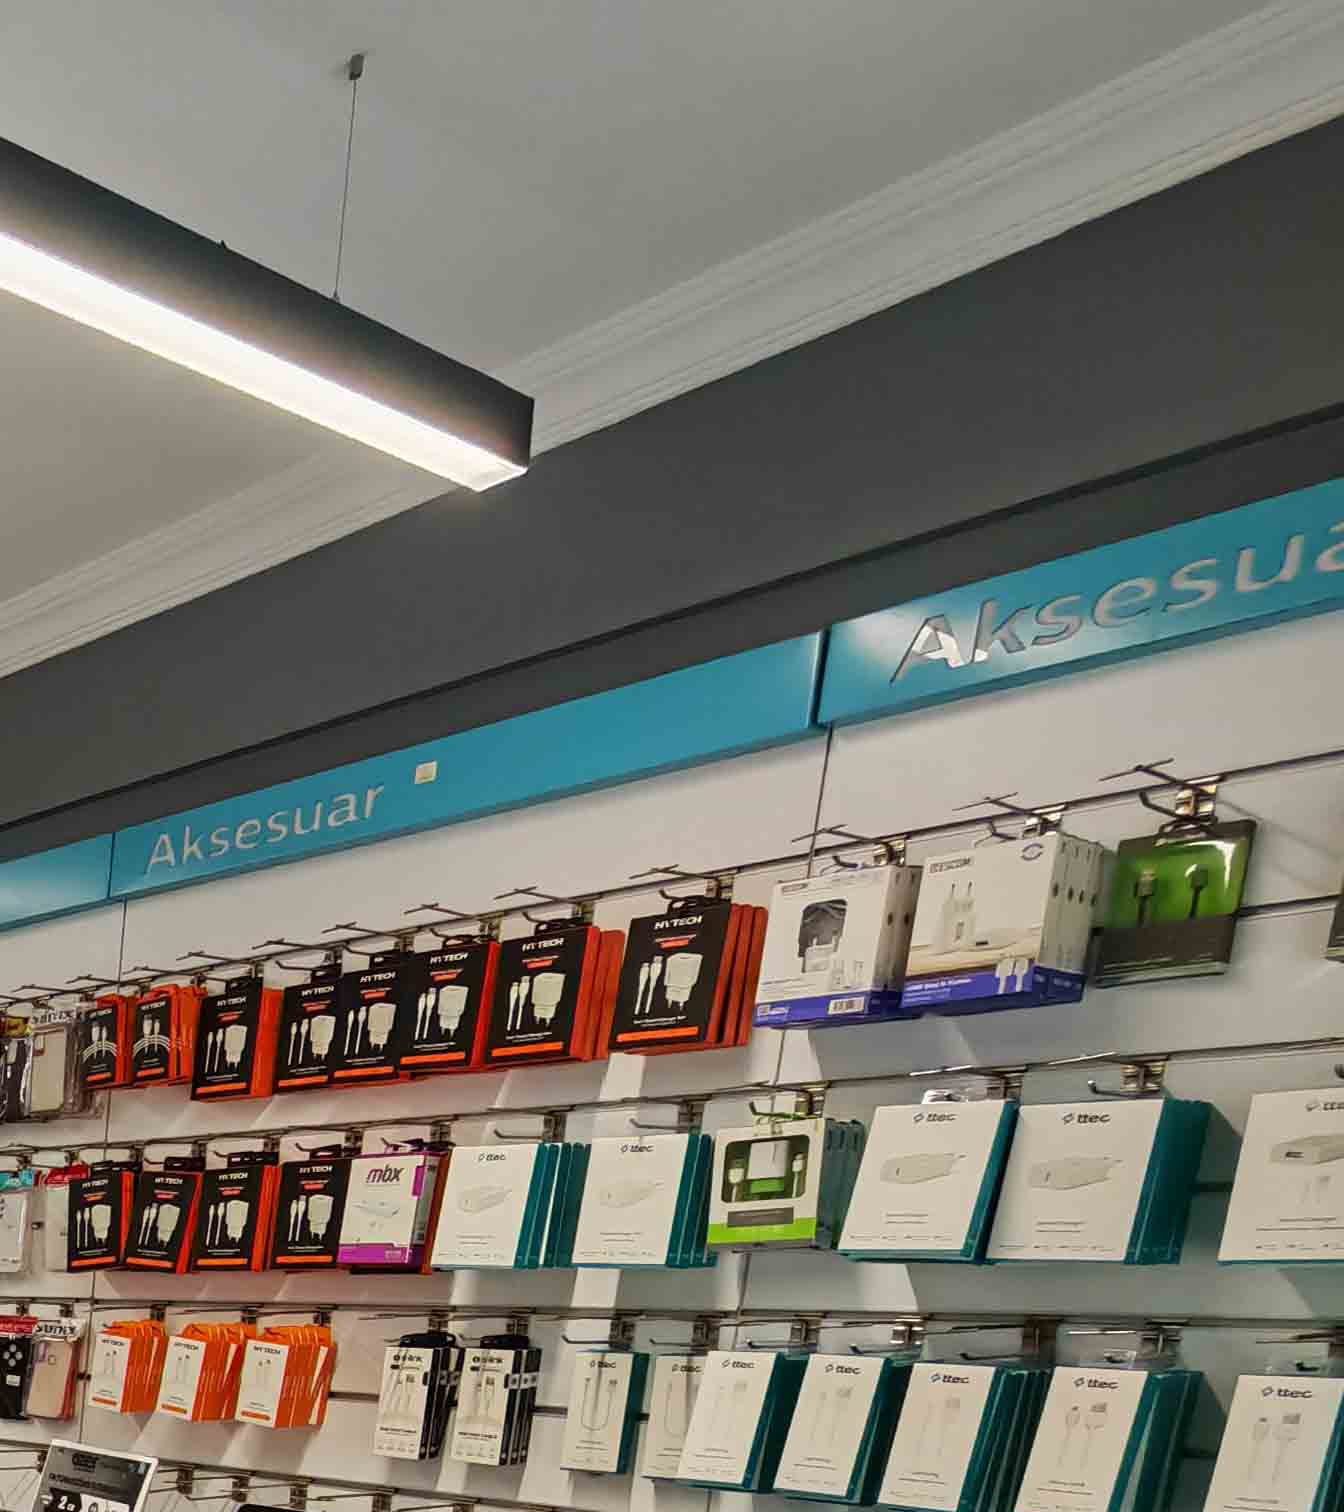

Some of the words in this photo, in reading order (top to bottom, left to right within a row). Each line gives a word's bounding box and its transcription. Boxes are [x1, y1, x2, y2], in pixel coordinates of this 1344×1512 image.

[144, 781, 386, 878] Aksesuar
[366, 1165, 405, 1184] mbx
[58, 1495, 67, 1511] 2
